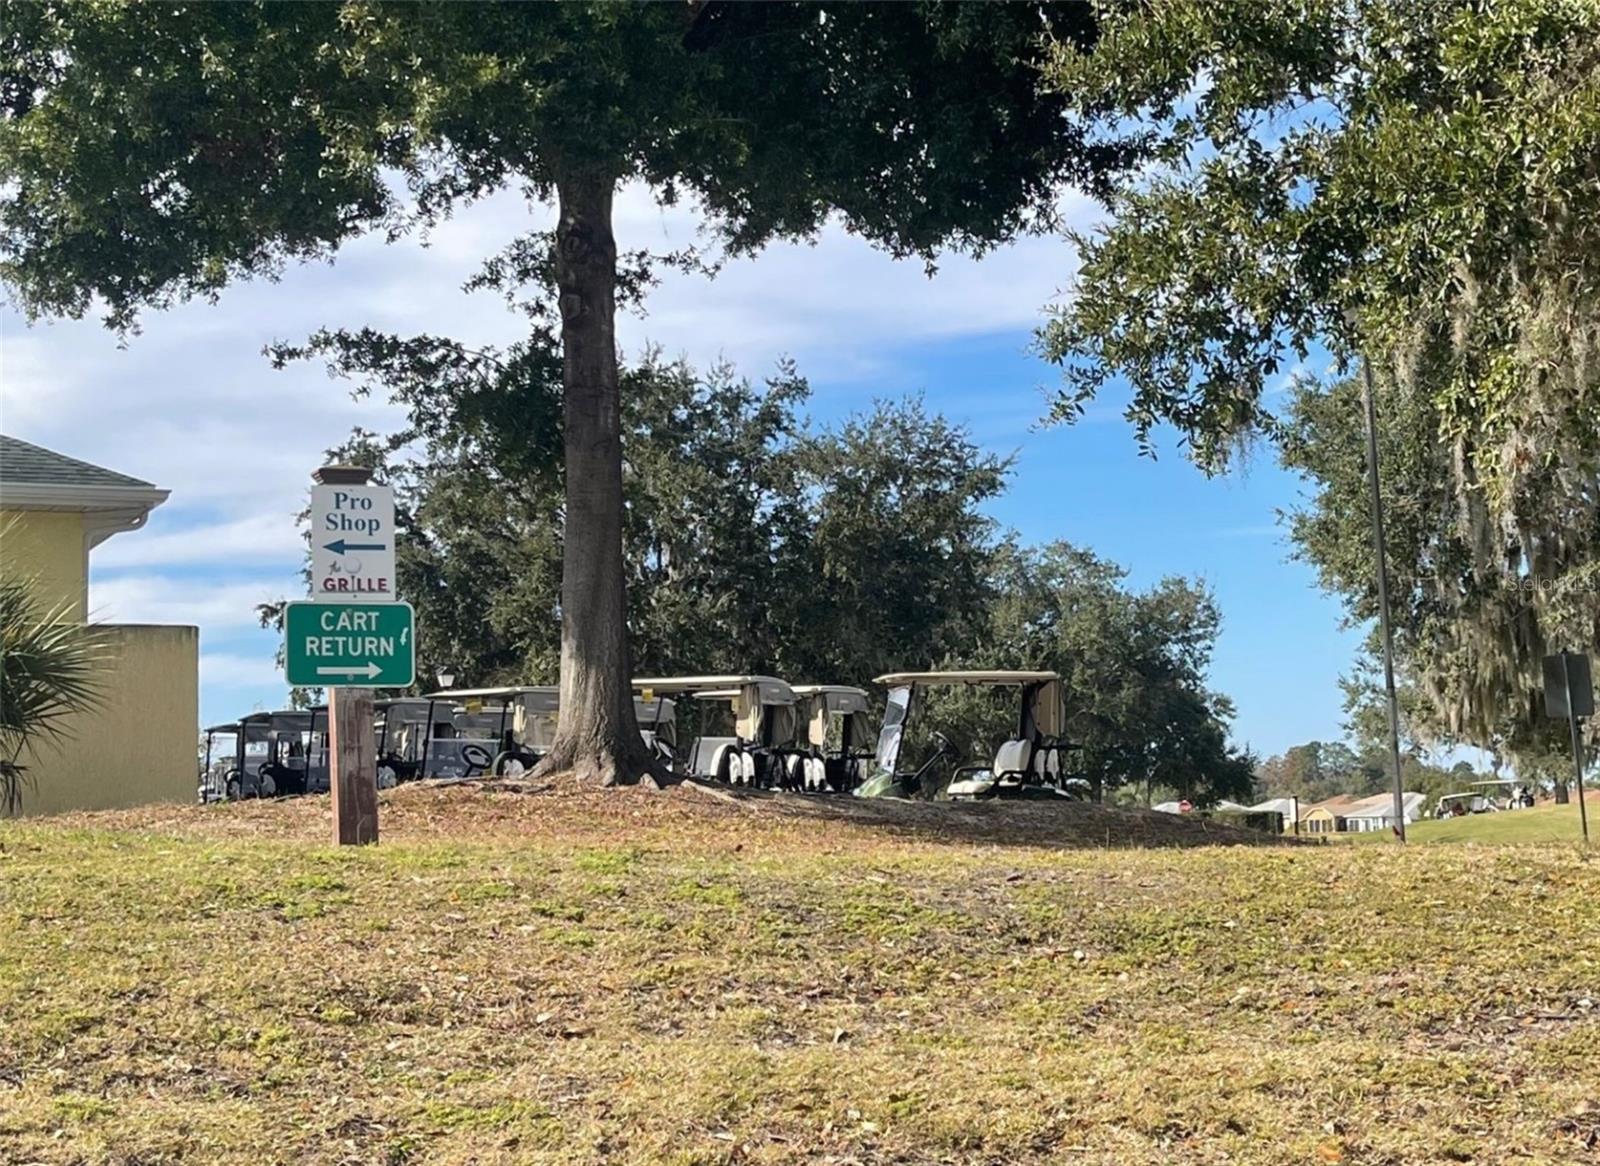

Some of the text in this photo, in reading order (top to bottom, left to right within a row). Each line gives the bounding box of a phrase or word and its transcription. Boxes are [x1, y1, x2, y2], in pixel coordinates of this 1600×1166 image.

[334, 492, 372, 510] Pro
[325, 513, 380, 536] Shop
[322, 575, 388, 592] GRILLE
[320, 611, 380, 631] CART
[305, 636, 394, 657] RETURN
